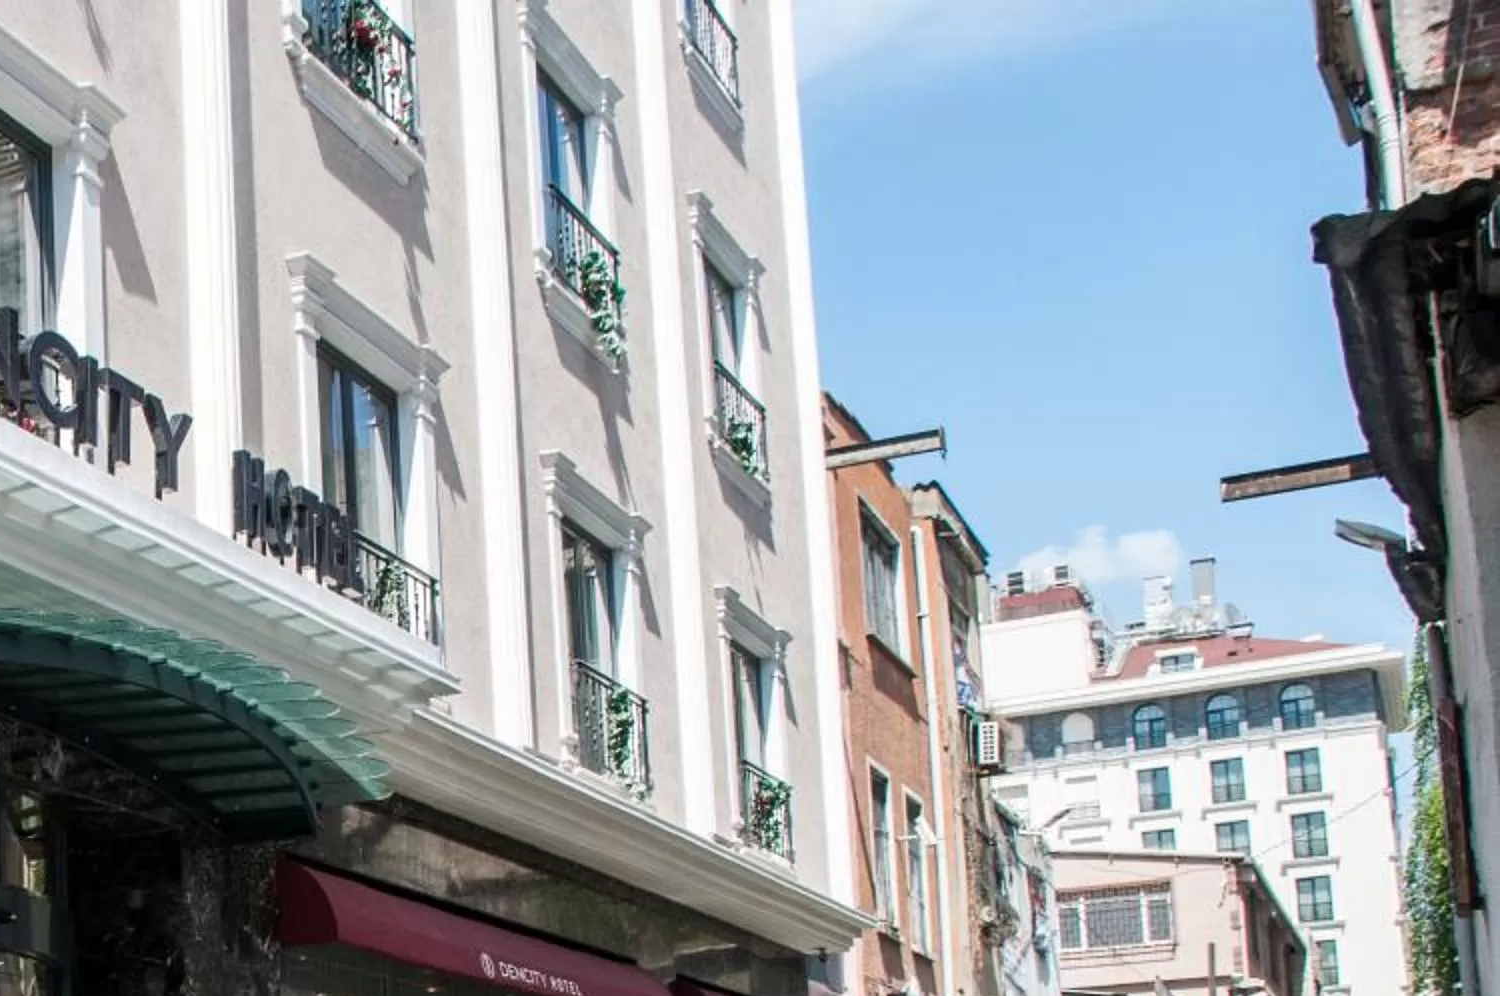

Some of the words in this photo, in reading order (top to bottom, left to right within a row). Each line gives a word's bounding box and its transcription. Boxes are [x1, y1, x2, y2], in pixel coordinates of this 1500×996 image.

[233, 450, 364, 594] HOTEL
[498, 961, 548, 989] DENCITY
[549, 975, 583, 996] HOTEL
